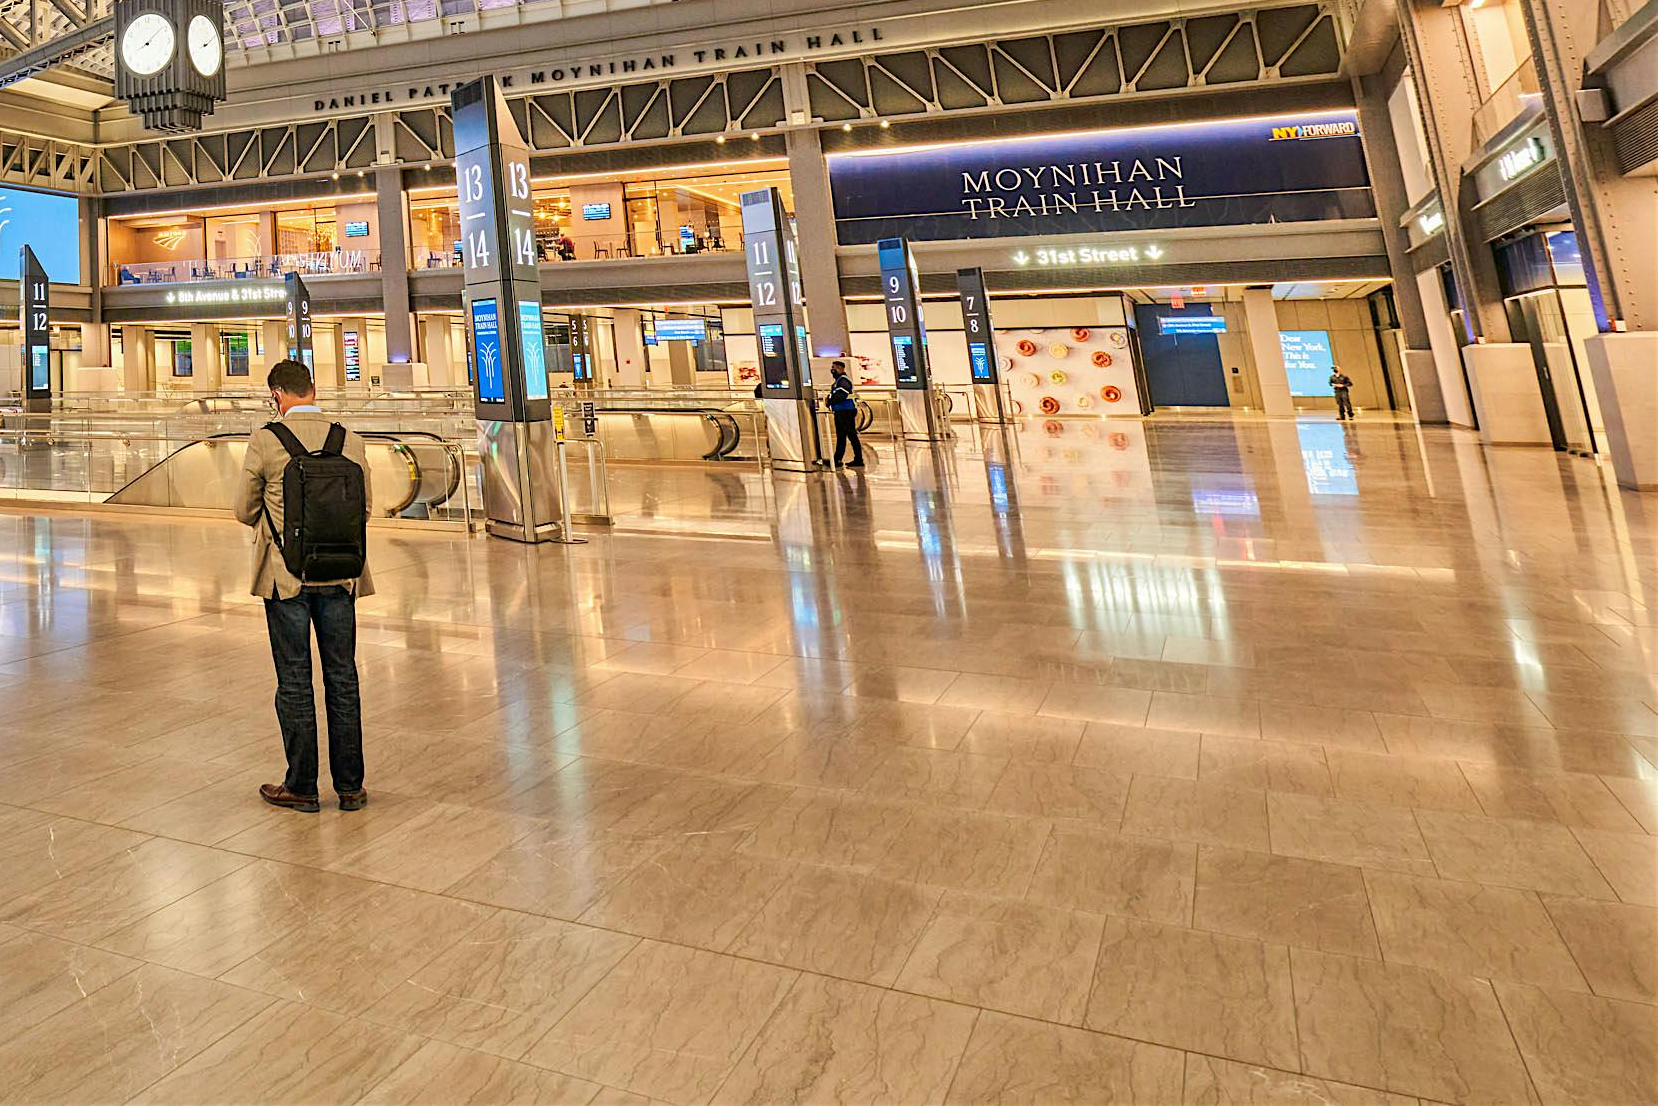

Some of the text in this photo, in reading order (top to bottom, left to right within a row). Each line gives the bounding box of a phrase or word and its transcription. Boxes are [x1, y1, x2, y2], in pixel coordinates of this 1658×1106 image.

[314, 27, 883, 111] DANIEL PATK MOYNIHAN TRAIN HALL
[464, 164, 484, 203] 13
[508, 161, 529, 200] 13
[961, 156, 1184, 194] MOYNIHAN
[961, 185, 1196, 220] TRAIN HALL
[468, 229, 490, 269] 14
[514, 227, 535, 266] 14
[753, 241, 770, 265] 11
[1036, 246, 1138, 265] 31st Street
[33, 282, 45, 301] 11
[756, 282, 776, 306] 12
[889, 276, 900, 294] 9
[178, 287, 287, 303] 8th Avenue & 31st Stre
[966, 296, 974, 310] 7
[287, 301, 293, 315] 9
[302, 300, 309, 315] 9
[891, 305, 907, 323] 10
[33, 312, 47, 331] 12
[571, 320, 577, 330] 5
[582, 319, 587, 329] 5
[970, 319, 979, 332] 8
[302, 324, 311, 338] 10
[1279, 334, 1302, 342] Dear
[573, 336, 578, 347] 6
[584, 336, 589, 347] 6
[1281, 343, 1301, 351] New
[1285, 352, 1301, 360] This
